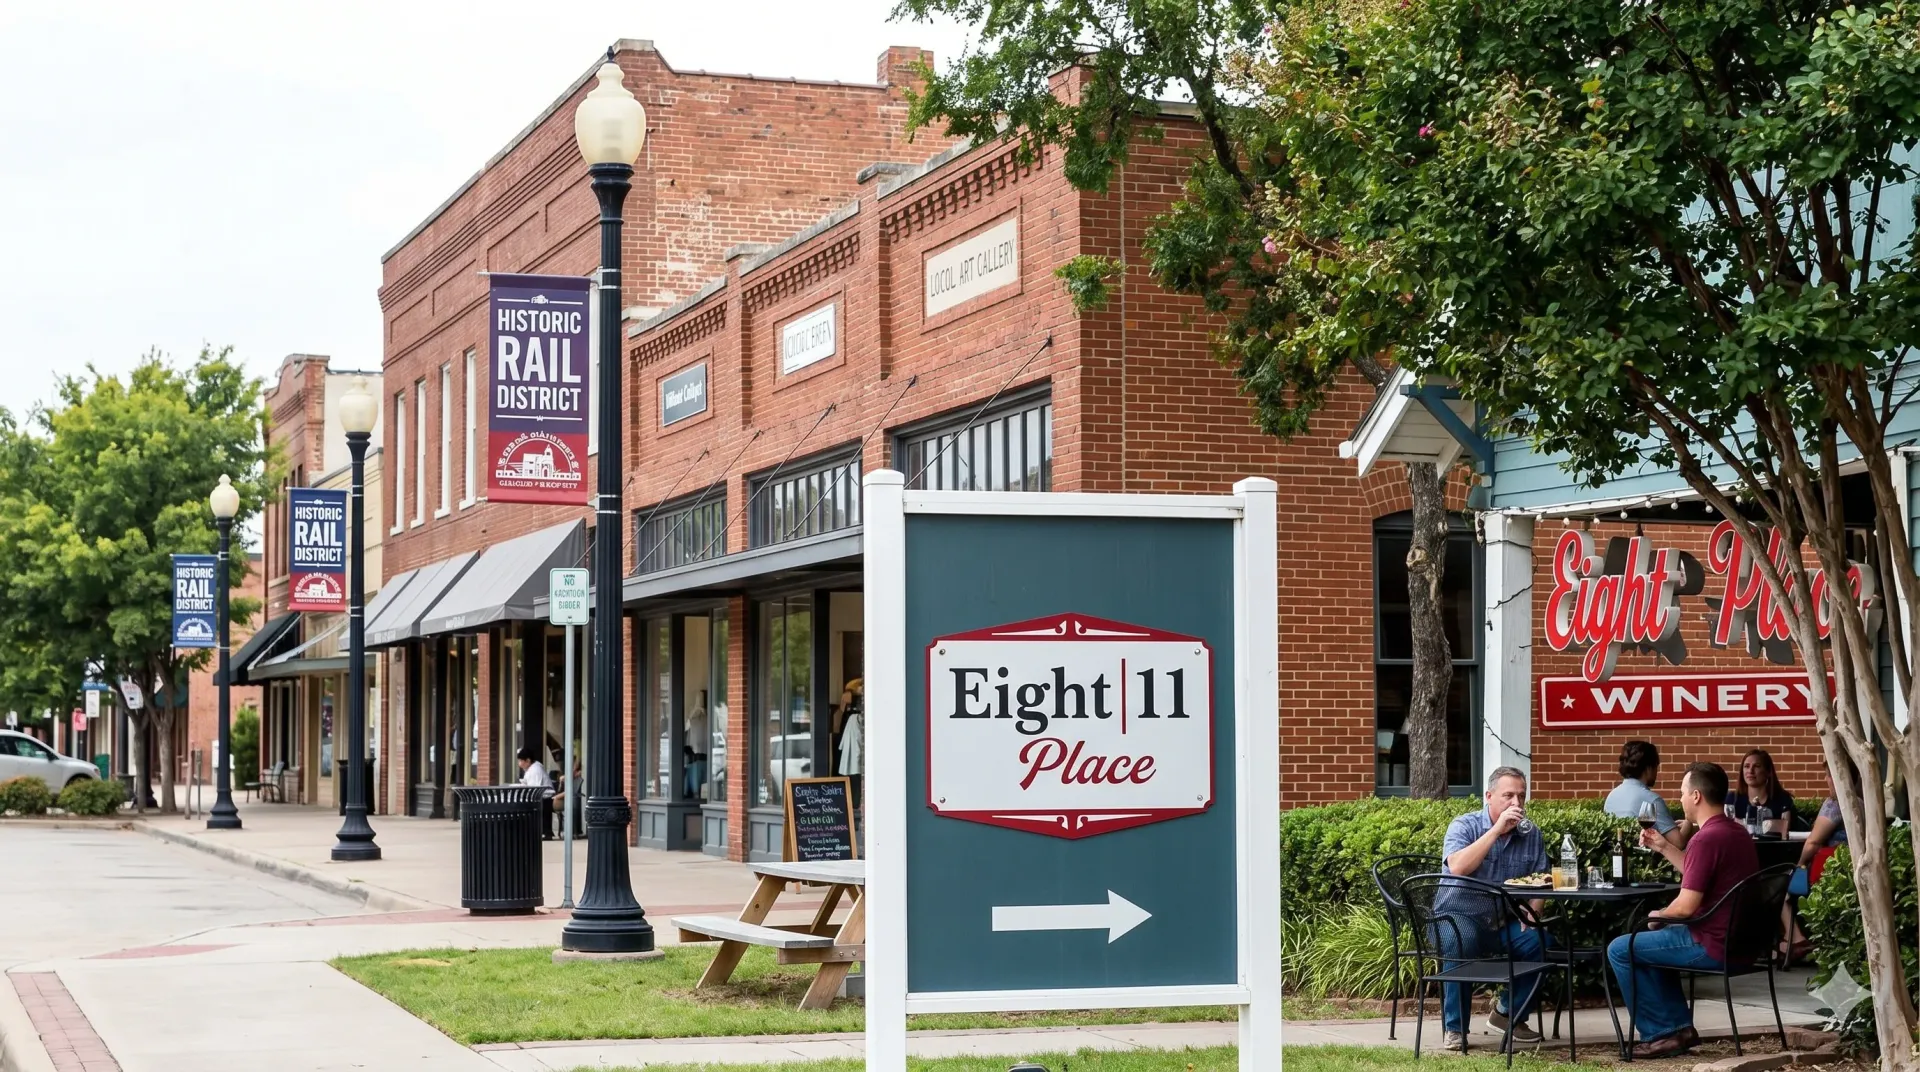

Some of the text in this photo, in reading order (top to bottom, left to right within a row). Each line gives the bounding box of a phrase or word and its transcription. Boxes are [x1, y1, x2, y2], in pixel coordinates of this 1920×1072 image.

[959, 256, 975, 286] ART
[497, 308, 582, 334] HISTORIC
[497, 335, 582, 383] RAIL
[497, 385, 582, 411] DISTRICT
[294, 506, 343, 521] HISTORIC
[294, 521, 343, 547] RAIL
[294, 547, 343, 562] DISTRICT
[176, 567, 214, 579] HISTORIC
[176, 579, 214, 598] RAIL
[176, 598, 214, 610] DISTRICT
[1544, 528, 1670, 682] Eight
[949, 666, 1191, 735] Eight 11
[1018, 737, 1157, 791] Place
